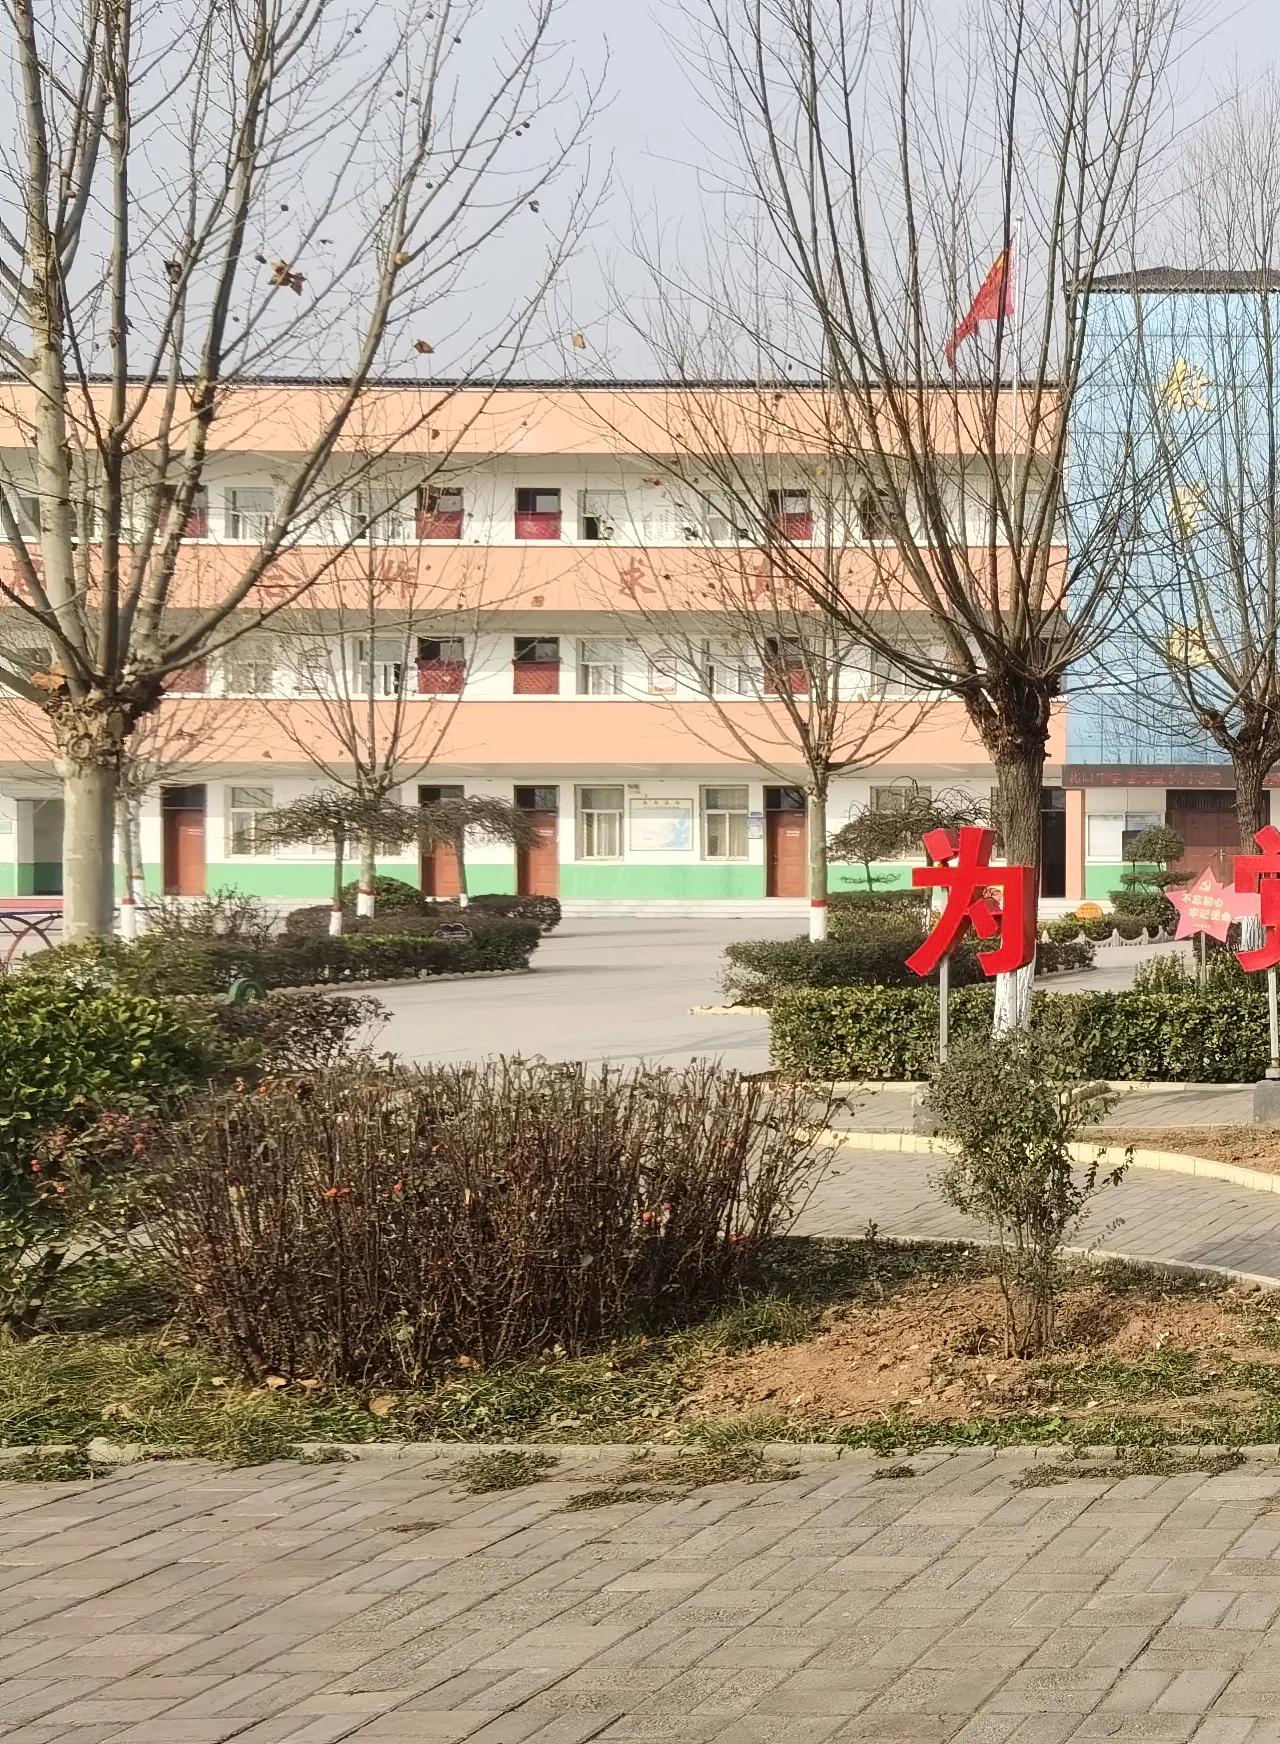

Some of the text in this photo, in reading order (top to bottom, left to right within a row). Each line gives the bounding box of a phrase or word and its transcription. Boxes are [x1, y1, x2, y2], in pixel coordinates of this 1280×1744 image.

[1182, 893, 1223, 907] 不忘初心
[1188, 908, 1231, 922] 牢记使命
